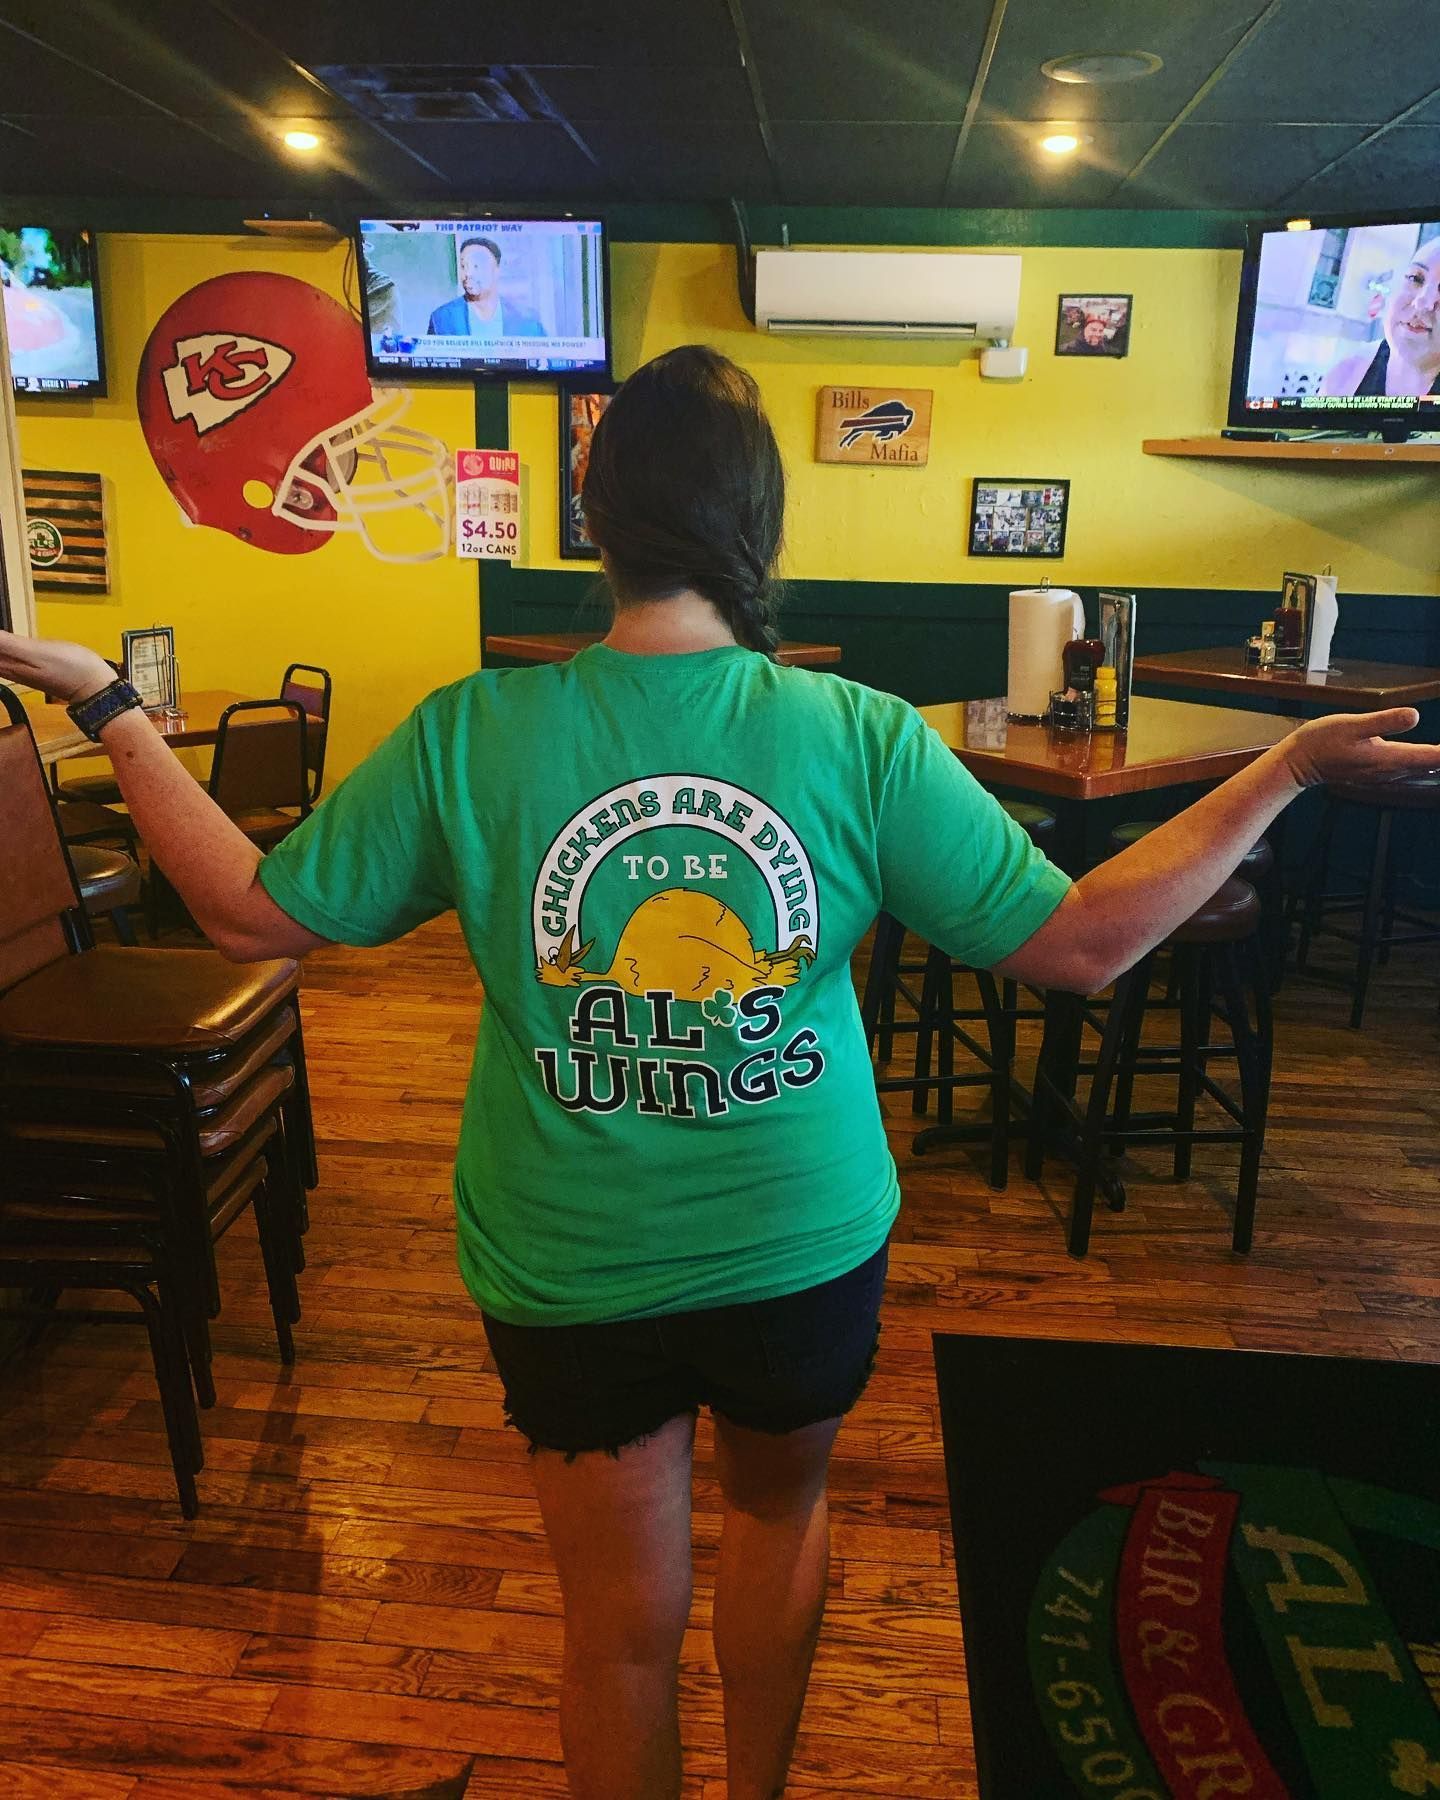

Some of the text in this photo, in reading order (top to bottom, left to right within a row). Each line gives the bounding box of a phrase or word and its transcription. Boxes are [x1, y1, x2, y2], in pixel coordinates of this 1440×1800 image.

[435, 223, 523, 232] THE PATRIOT WAY
[181, 341, 272, 400] KC
[832, 391, 870, 409] Bills
[870, 443, 918, 461] Mafia
[462, 519, 517, 540] $4.50
[486, 544, 517, 555] CANS
[541, 787, 811, 937] CHICKENS ARE DYING
[622, 854, 728, 880] TO BE
[535, 1027, 825, 1119] WINGS
[1138, 1499, 1215, 1607] BAR
[1137, 1620, 1200, 1674] &
